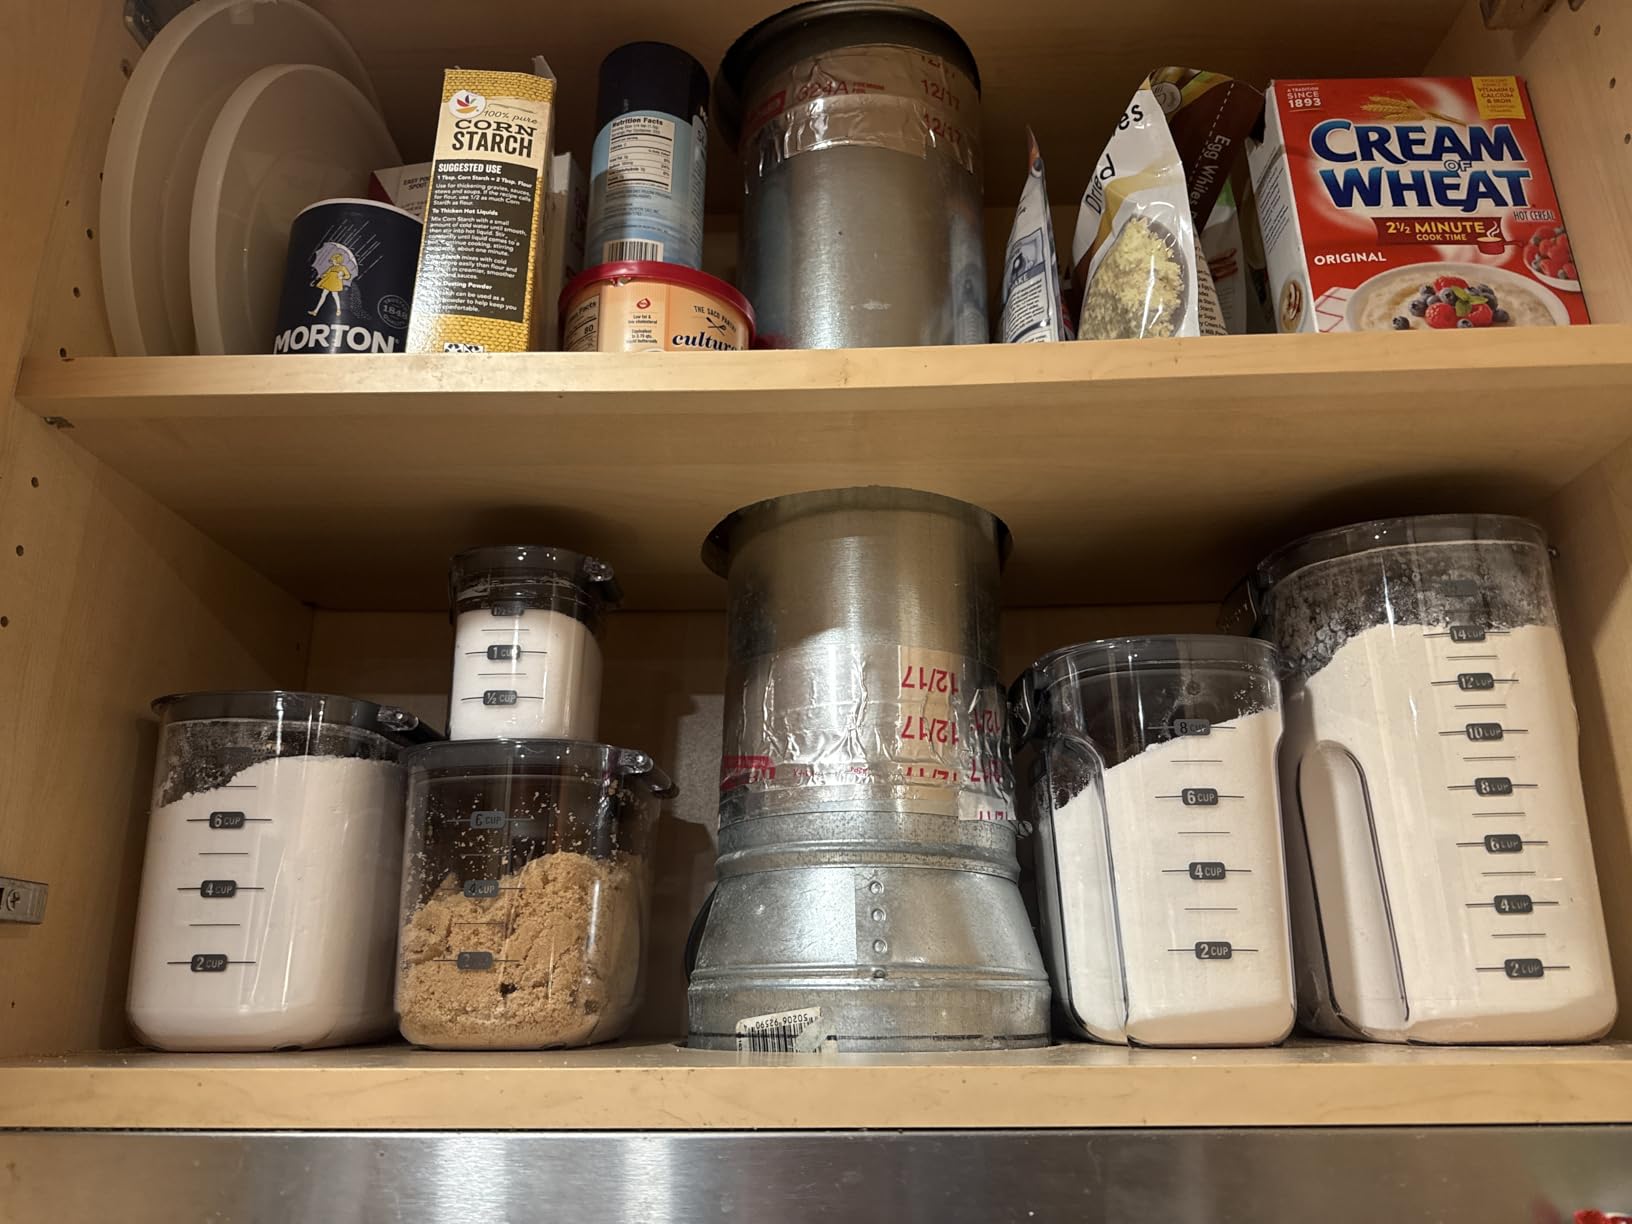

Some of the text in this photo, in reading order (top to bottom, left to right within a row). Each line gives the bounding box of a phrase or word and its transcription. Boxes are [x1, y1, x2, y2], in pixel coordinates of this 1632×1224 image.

[1287, 91, 1319, 99] SINCE
[1289, 98, 1321, 108] 1893
[484, 110, 538, 124] 100% pure
[612, 117, 663, 127] Nutrition Facts
[1118, 103, 1144, 131] es
[455, 120, 537, 137] CORN
[452, 131, 533, 158] STARCH
[1310, 120, 1527, 165] CREAM
[438, 163, 502, 174] SUGGESTED USE
[1190, 135, 1231, 205] Egg Whites
[1444, 159, 1472, 172] OF
[1086, 153, 1115, 216] Dried
[1319, 166, 1532, 213] WHEAT
[1513, 211, 1555, 220] HOT CEREAL
[1415, 222, 1485, 233] MINUTE
[493, 243, 514, 252] stirring
[1314, 251, 1386, 265] ORIGINAL
[487, 270, 515, 278] smoother
[468, 282, 492, 290] Powder
[475, 299, 488, 307] help
[489, 301, 504, 309] keep
[707, 308, 720, 319] SACO
[274, 324, 395, 354] MORTON
[1452, 629, 1466, 640] 14
[901, 666, 959, 695] 12/17
[1460, 676, 1474, 688] 12
[900, 716, 959, 745] 12/17
[1179, 722, 1188, 734] 8
[1468, 726, 1483, 739] 10
[1481, 780, 1490, 794] 8
[1186, 790, 1215, 804] 6 CUP
[213, 814, 241, 827] 6 CUP
[1490, 838, 1500, 851] 6
[1194, 864, 1222, 878] 4 CUP
[205, 882, 233, 896] 4 CUP
[478, 885, 495, 894] CUP
[1500, 899, 1510, 912] 4
[1200, 944, 1229, 958] 2 CUP
[196, 956, 224, 970] 2 CUP
[1510, 962, 1519, 976] 2
[756, 1014, 808, 1029] 50206 92590
